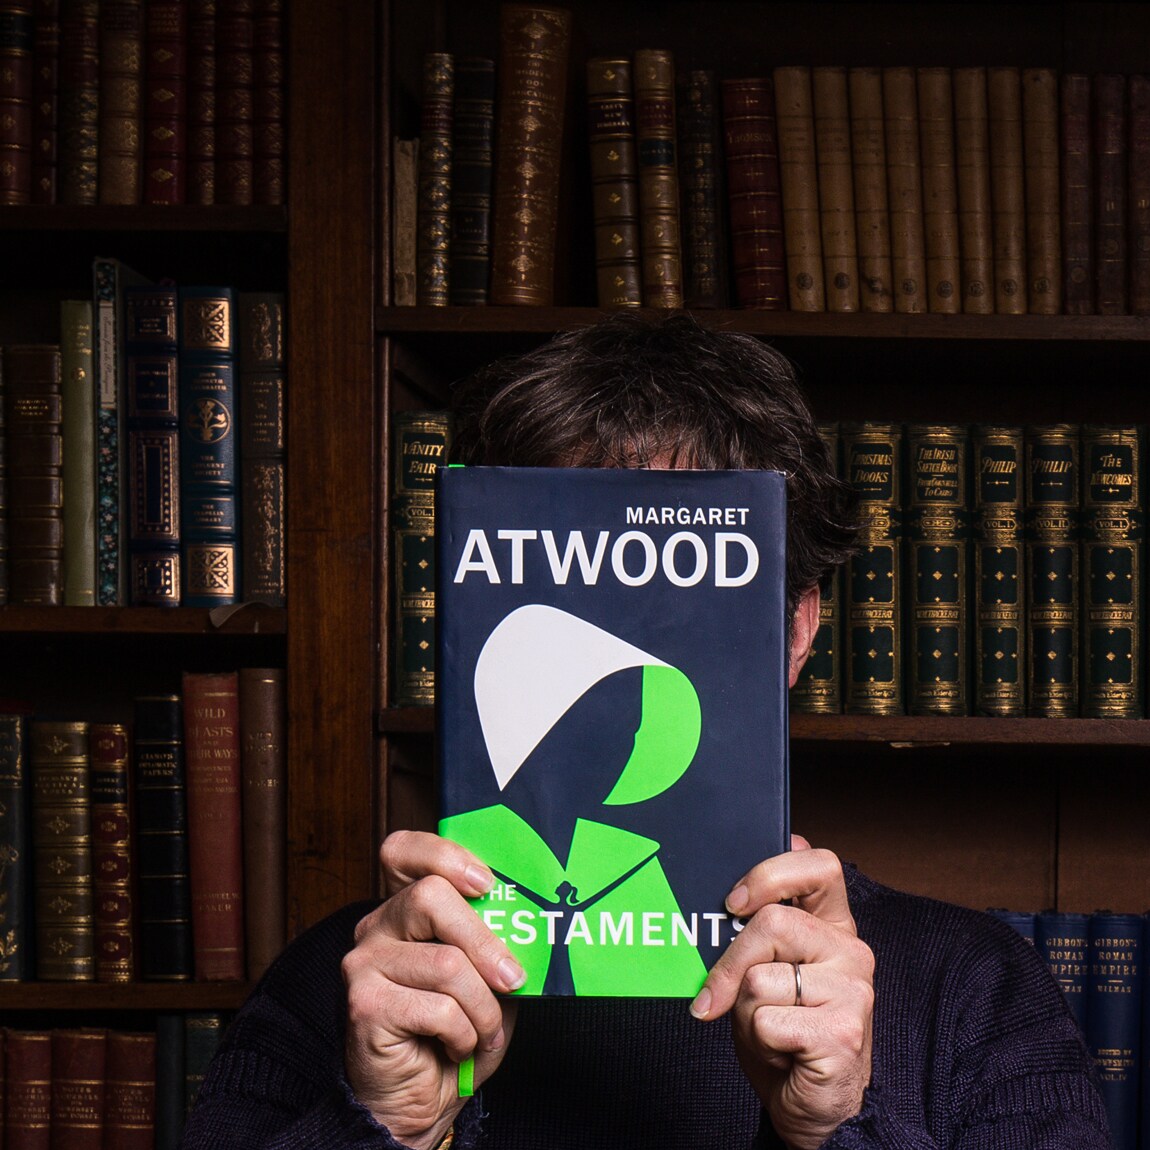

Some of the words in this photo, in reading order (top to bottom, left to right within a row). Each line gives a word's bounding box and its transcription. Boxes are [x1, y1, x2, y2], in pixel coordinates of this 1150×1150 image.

[403, 441, 444, 456] VANITY
[409, 461, 437, 474] FAIR
[981, 457, 1016, 473] PHILIP
[1032, 458, 1072, 473] PHILIP
[1100, 453, 1122, 468] THE
[854, 470, 888, 483] BOOKS
[626, 507, 749, 526] MARGARET
[453, 529, 760, 588] ATWOOD
[194, 708, 226, 718] WILD
[480, 884, 516, 901] HE
[478, 910, 749, 947] ESTAMENT
[1046, 938, 1088, 948] GIBBON'S
[1094, 938, 1137, 948] GIBBON'S
[1050, 951, 1084, 960] ROMAN
[1099, 951, 1133, 960] ROMAN
[1093, 965, 1137, 976] EMPIRE
